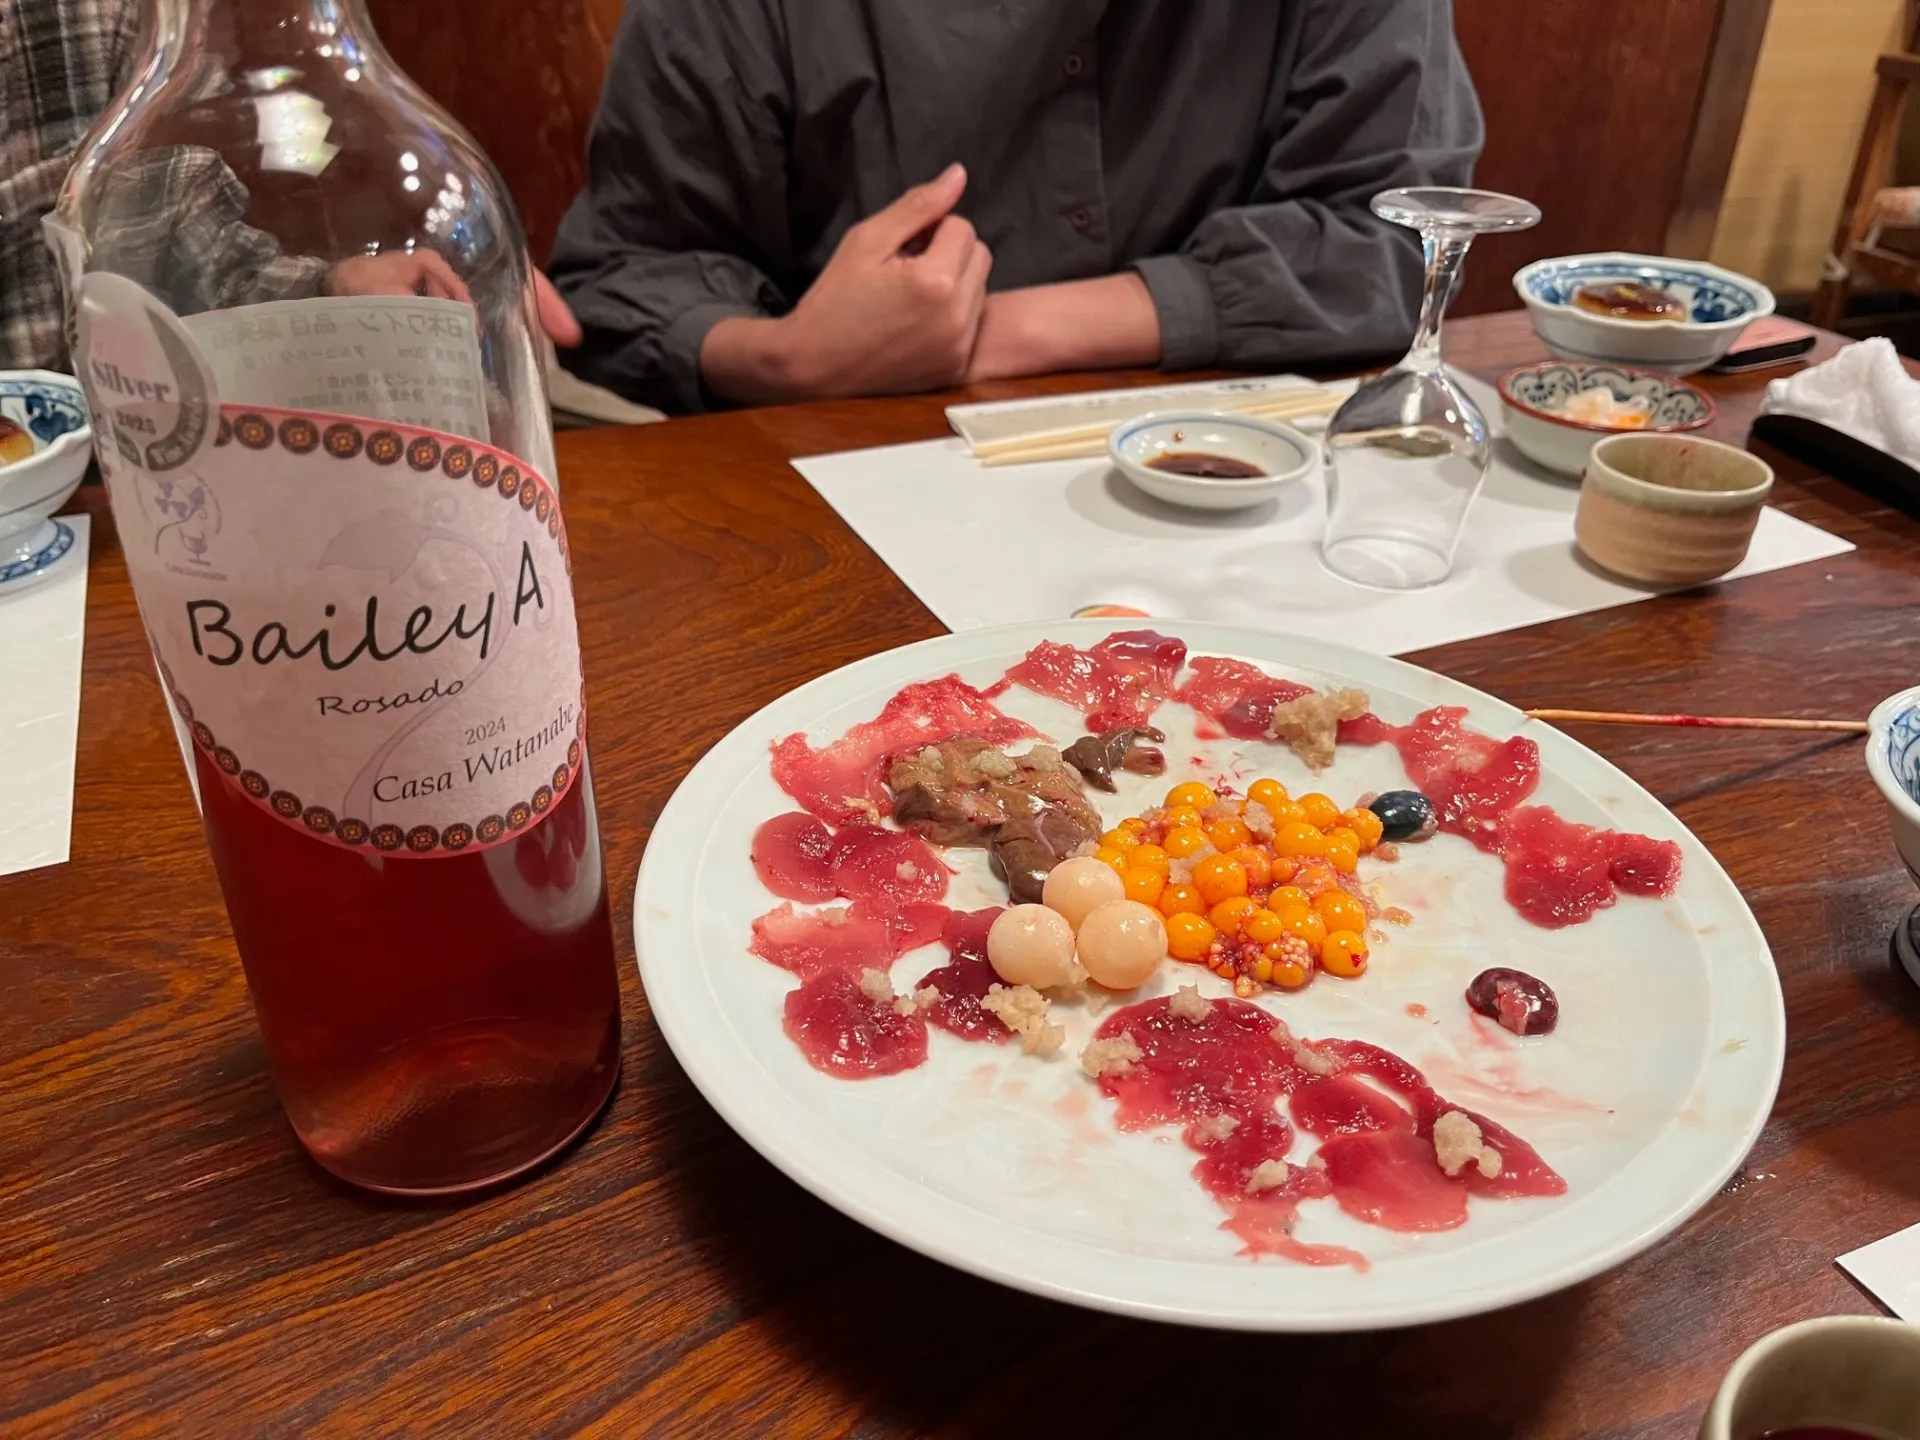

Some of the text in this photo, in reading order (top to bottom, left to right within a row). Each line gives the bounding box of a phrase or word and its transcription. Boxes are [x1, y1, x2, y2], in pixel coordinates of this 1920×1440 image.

[92, 360, 171, 403] Silver
[186, 540, 544, 671] Bailey A
[317, 678, 465, 716] Rosado
[373, 701, 575, 804] Casa Watanabe
[464, 716, 507, 746] 2024
